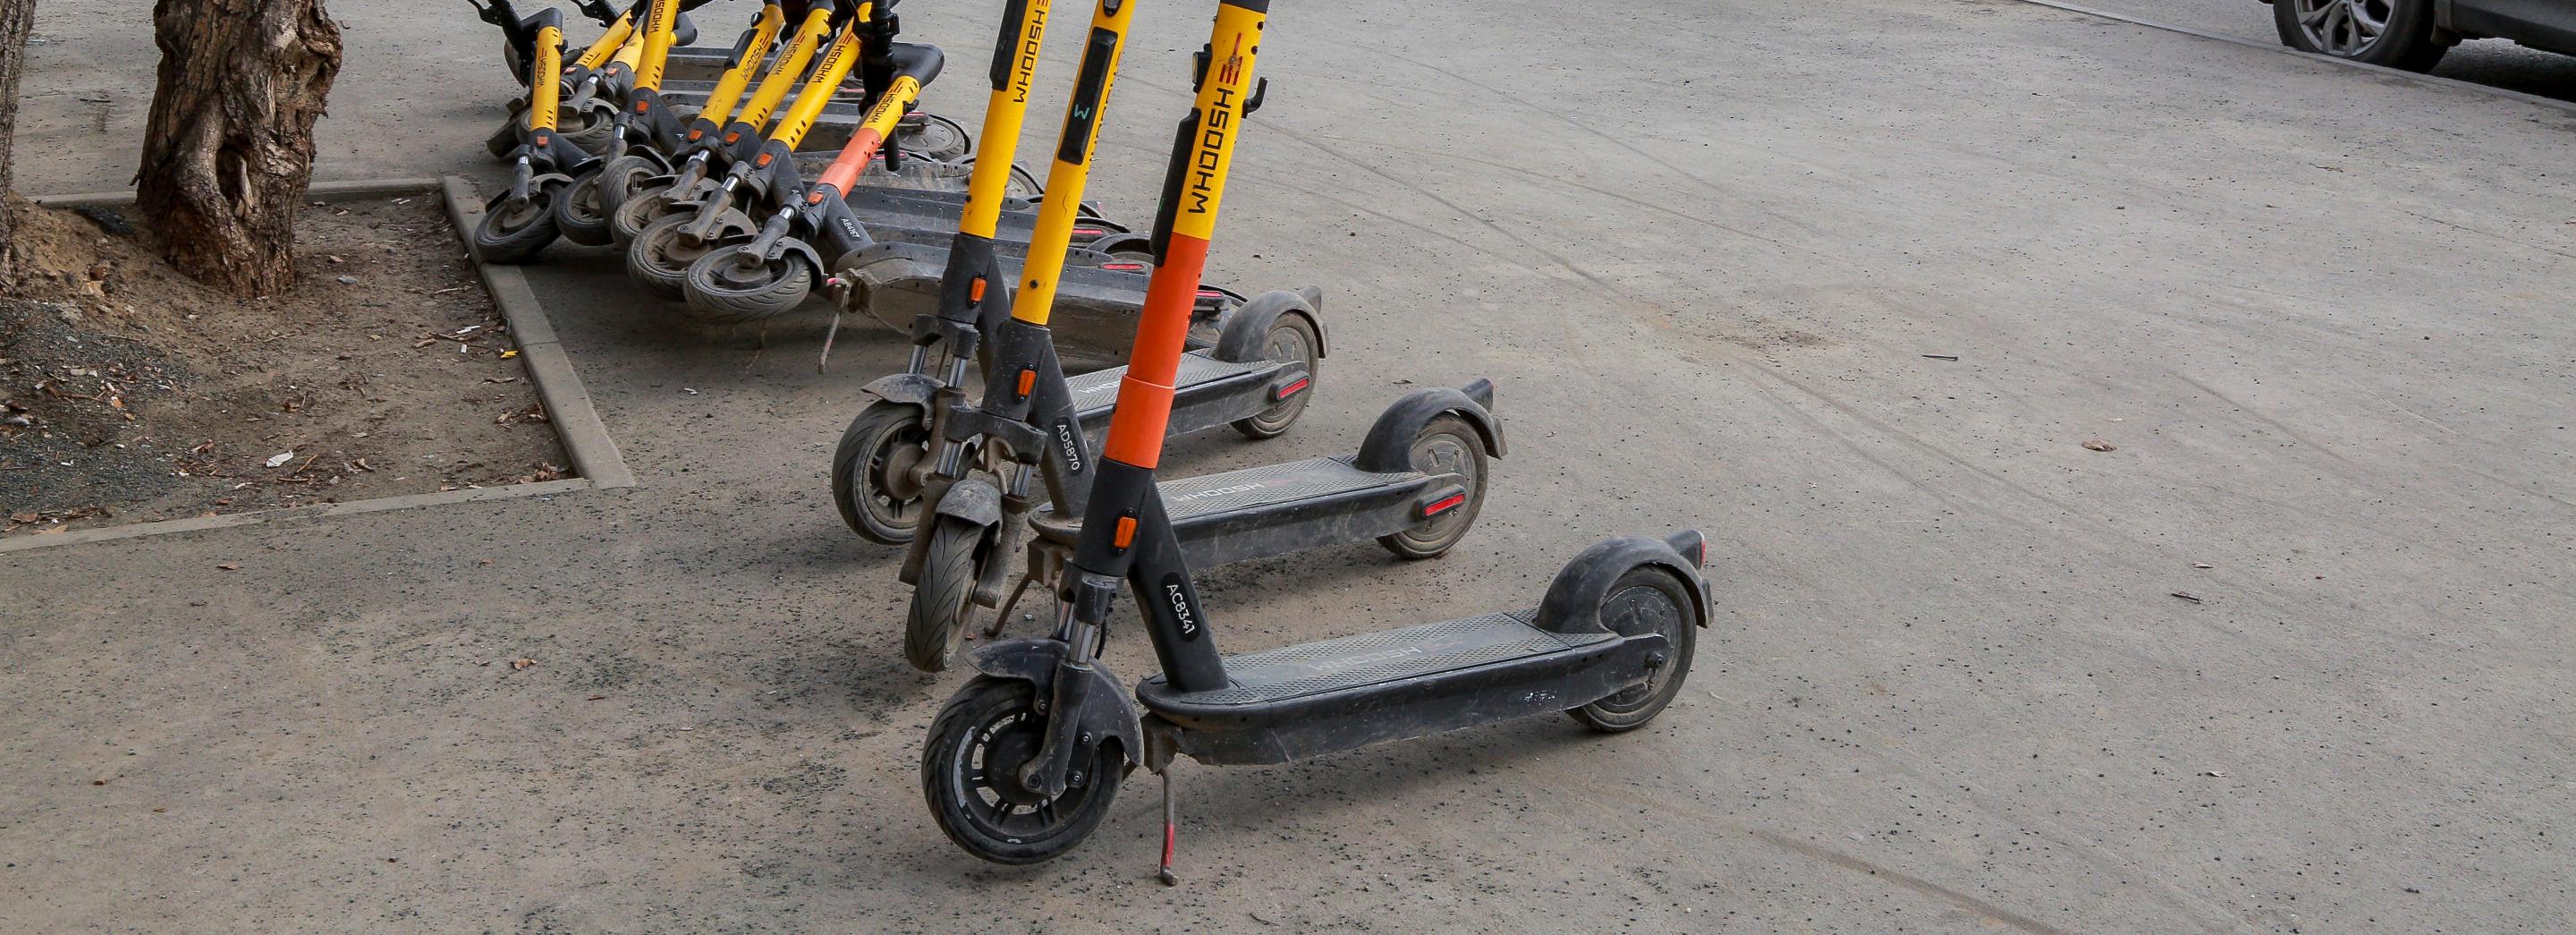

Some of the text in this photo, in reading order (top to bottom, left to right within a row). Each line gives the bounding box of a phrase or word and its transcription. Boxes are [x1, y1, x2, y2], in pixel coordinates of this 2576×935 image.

[650, 0, 665, 33] WHOOS
[741, 44, 766, 81] WHOOSH
[772, 43, 800, 75] WHOOSH
[812, 45, 846, 83] WHOOSH
[1013, 9, 1046, 103] WHOOSH
[868, 93, 898, 123] WHOOSH
[1074, 104, 1090, 120] W
[1188, 87, 1234, 214] WHOOSH
[1056, 423, 1080, 471] AD5870
[1172, 482, 1265, 502] WHOOSH
[1166, 583, 1196, 634] AC8341
[1308, 645, 1423, 671] WHOOSH
